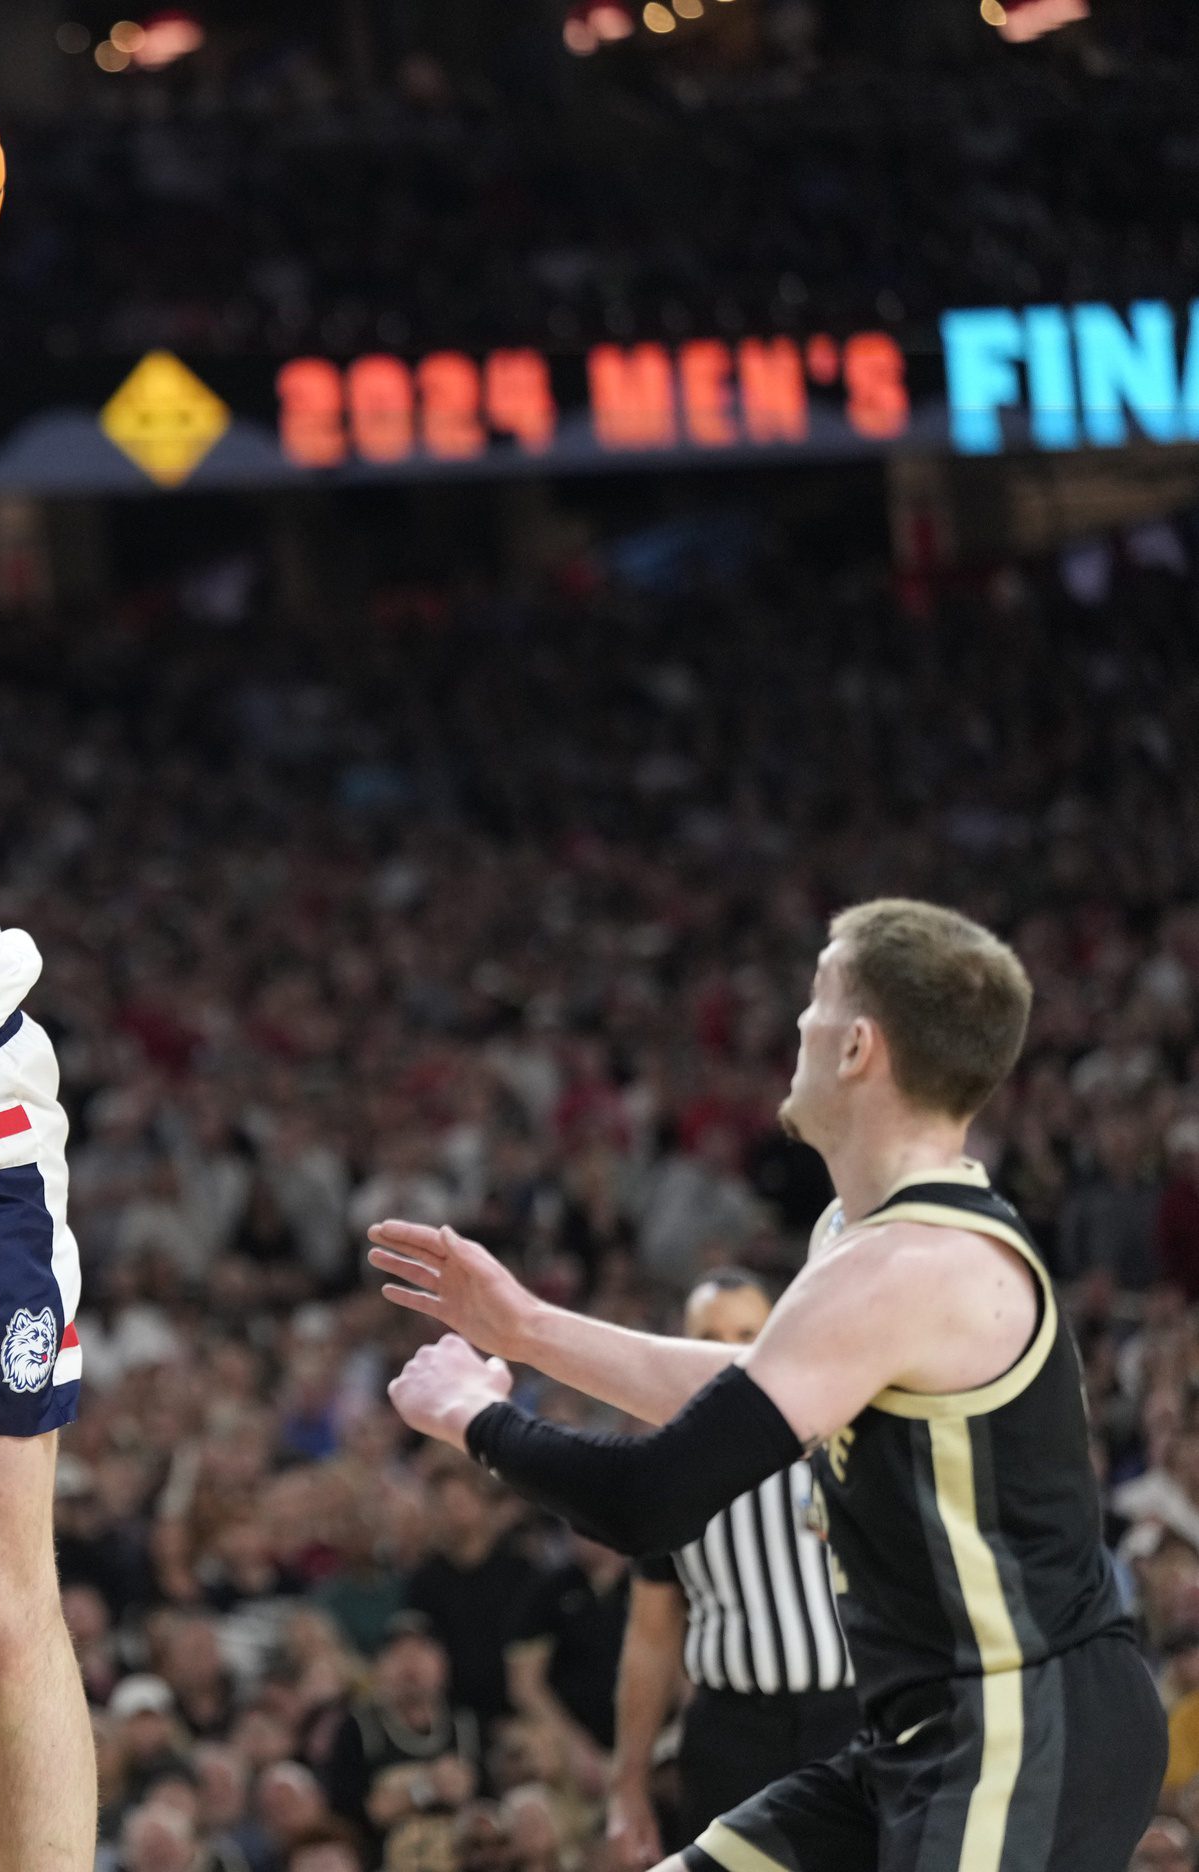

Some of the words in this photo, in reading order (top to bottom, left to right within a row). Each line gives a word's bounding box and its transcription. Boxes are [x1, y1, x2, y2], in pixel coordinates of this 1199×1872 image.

[276, 347, 557, 470] 2024
[587, 330, 910, 451] MEN'S
[940, 298, 1199, 456] FIN
